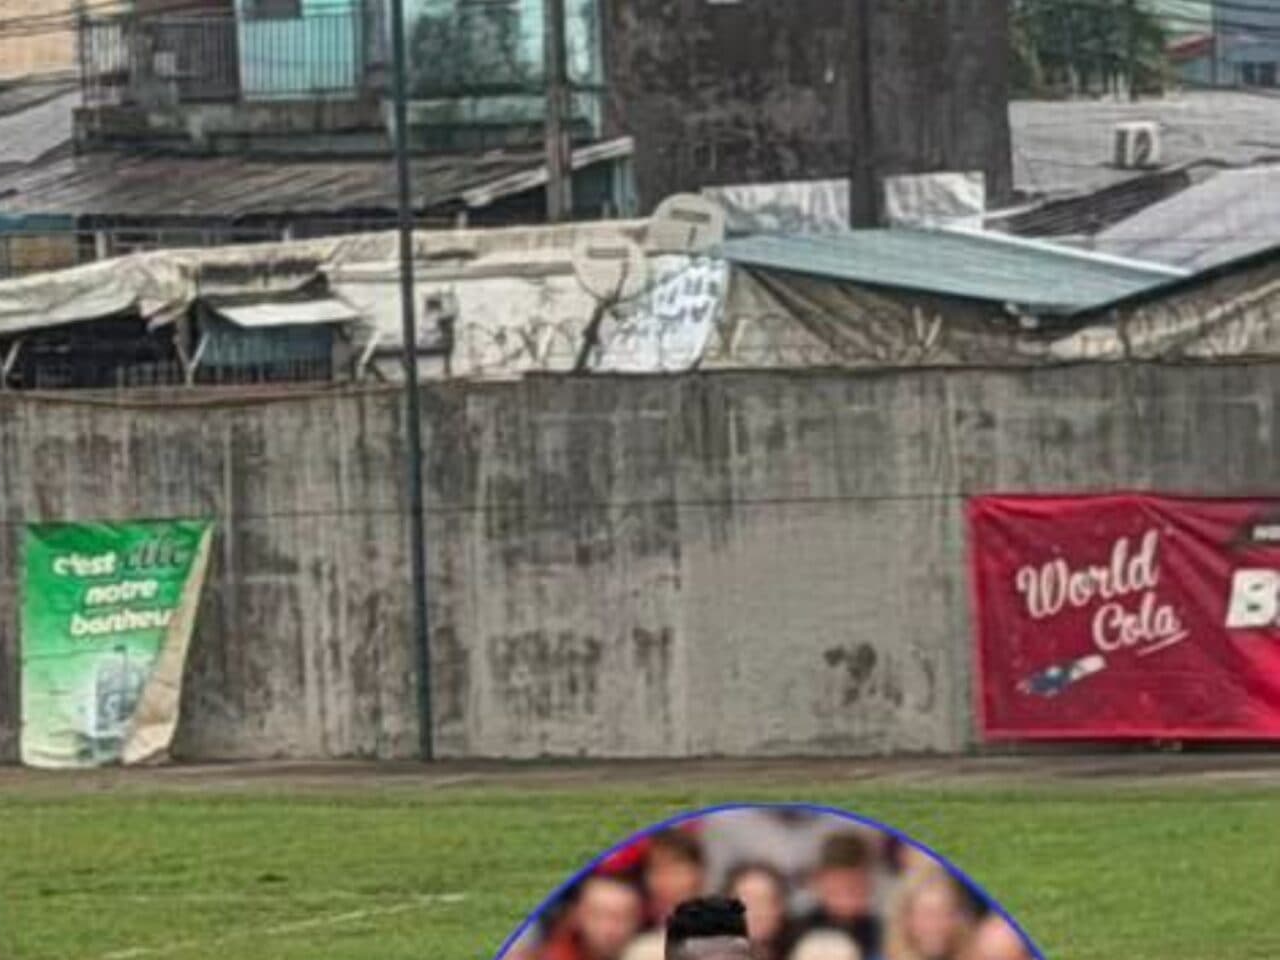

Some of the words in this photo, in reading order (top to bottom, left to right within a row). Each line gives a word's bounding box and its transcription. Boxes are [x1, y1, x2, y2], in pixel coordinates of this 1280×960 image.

[84, 579, 160, 606] notre
[1016, 529, 1160, 618] World
[1092, 591, 1184, 652] Cola
